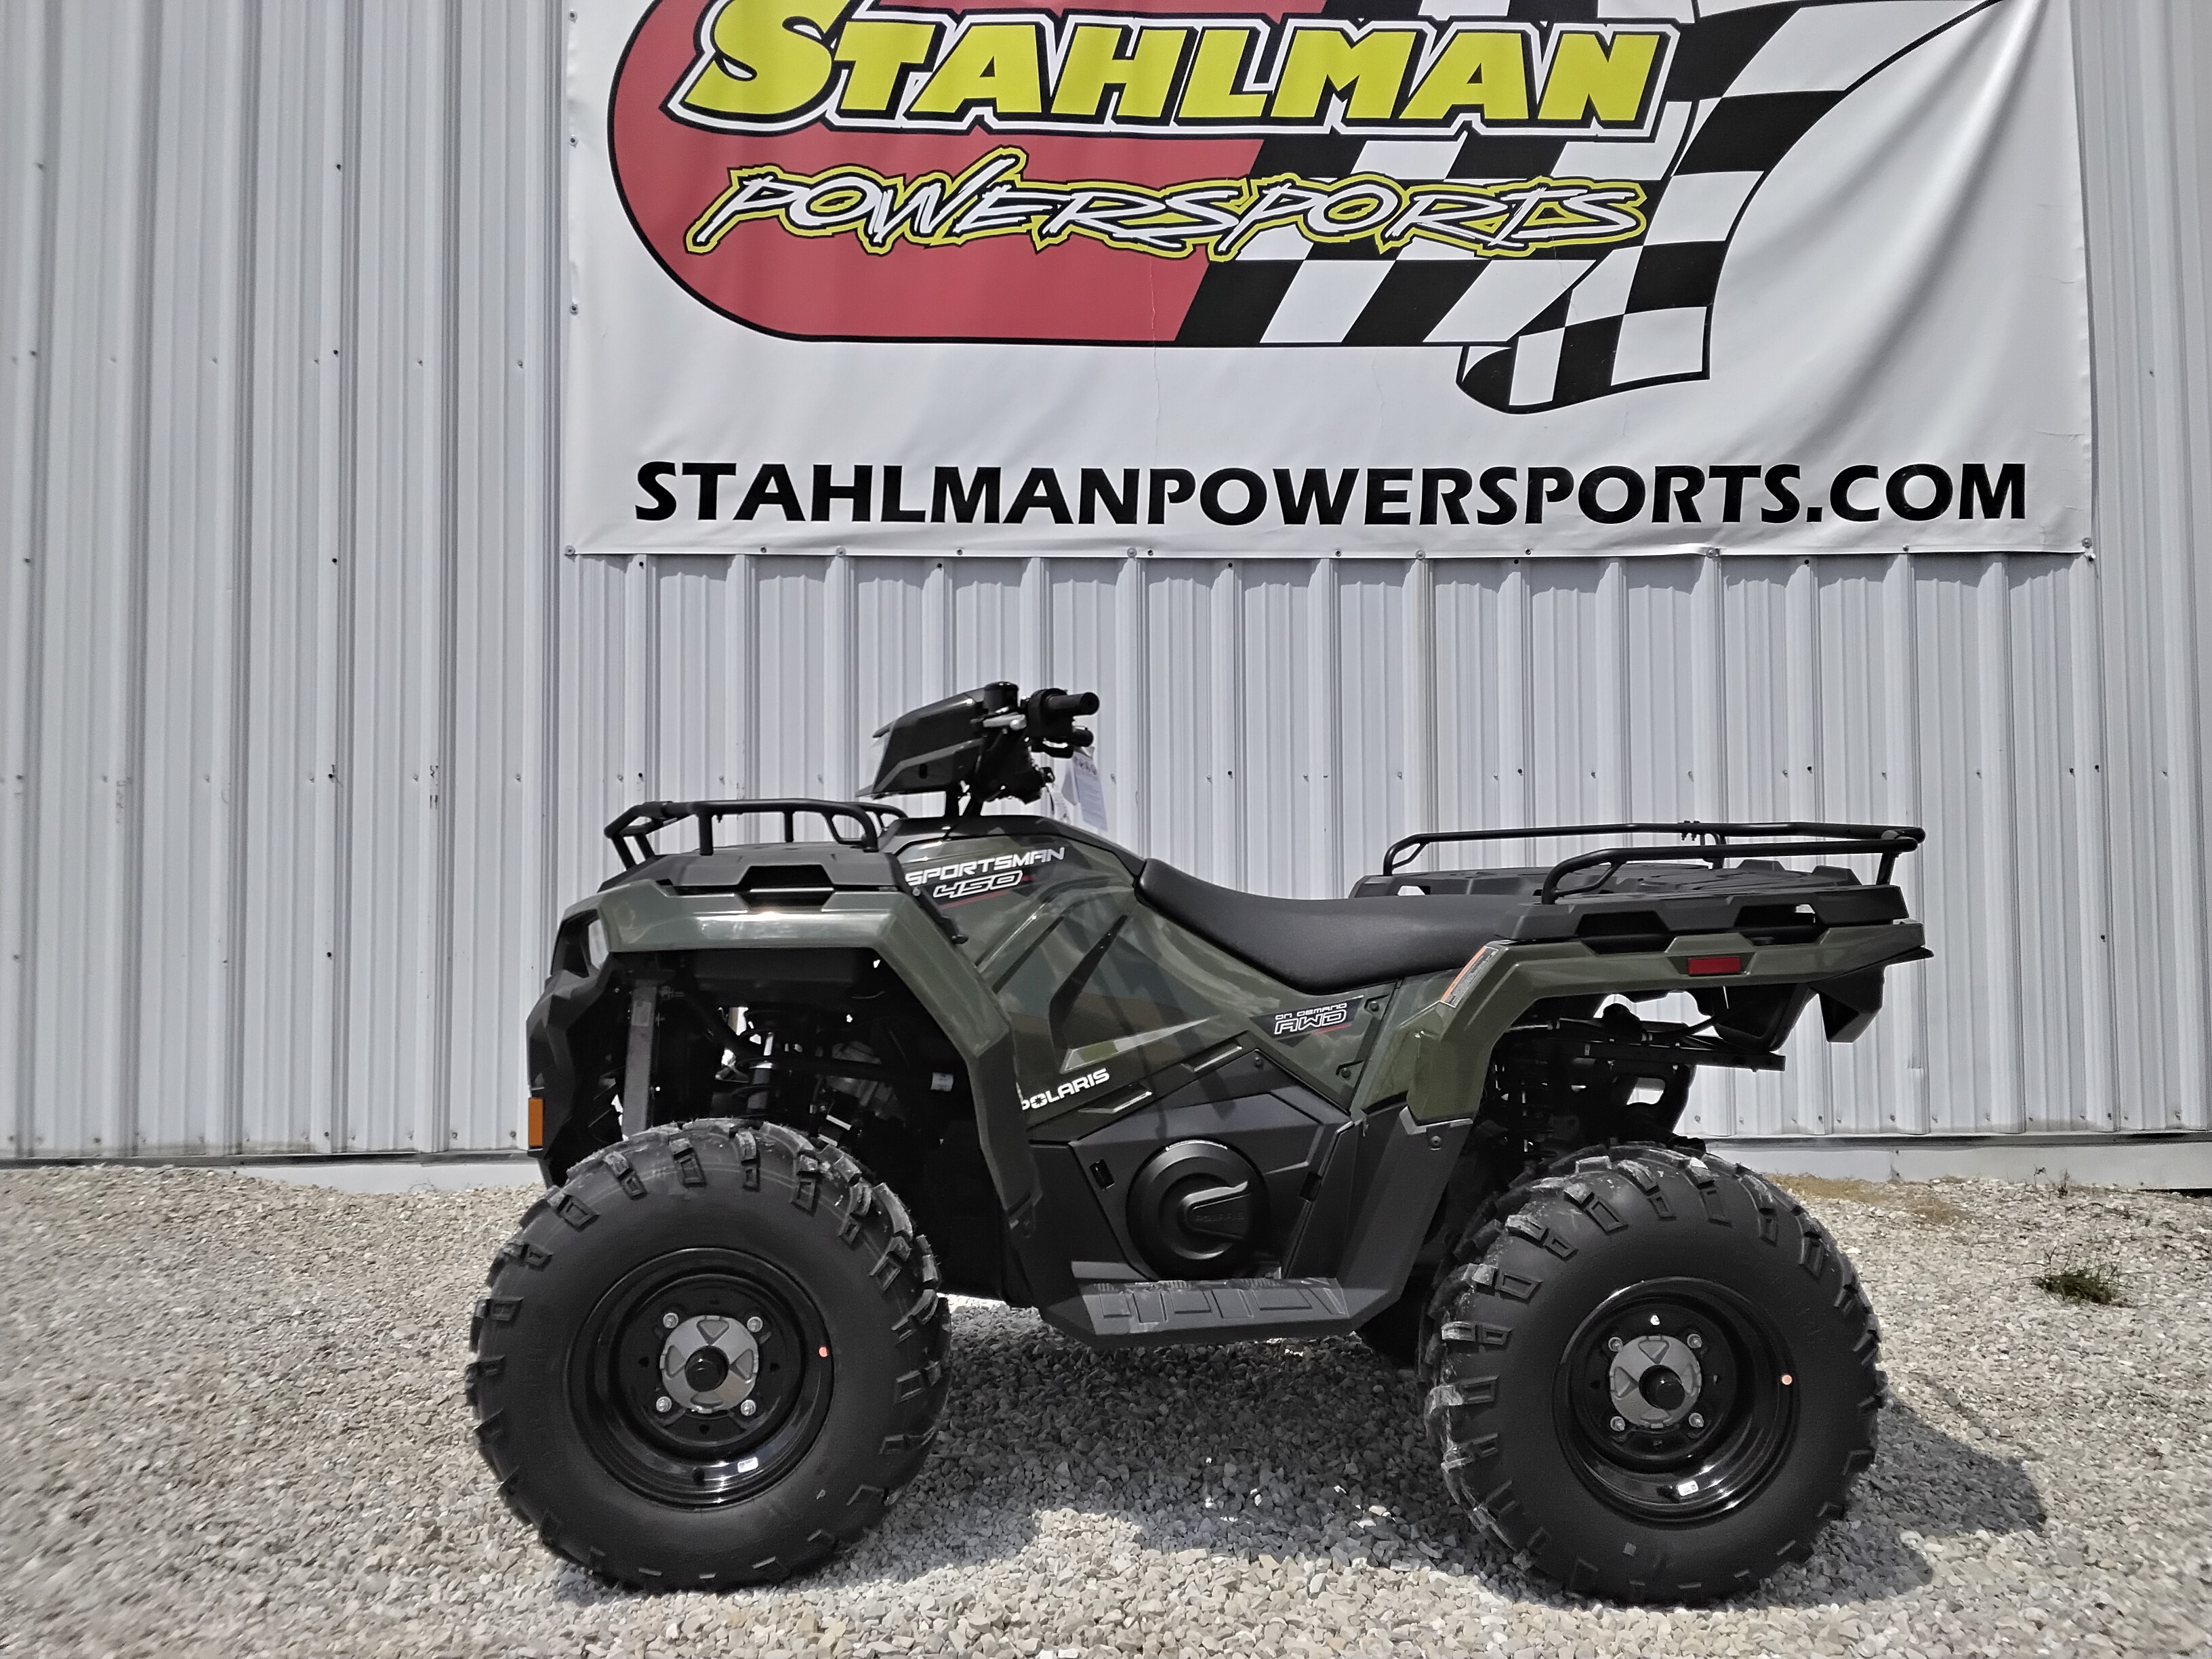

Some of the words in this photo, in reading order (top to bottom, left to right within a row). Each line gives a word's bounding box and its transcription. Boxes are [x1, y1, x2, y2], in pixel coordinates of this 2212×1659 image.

[668, 0, 1674, 136] STAHLMAN
[690, 150, 1641, 256] POWERSPORTS
[635, 461, 2026, 526] STAHLMANPOWERSPORTS.COM
[905, 847, 1065, 886] SPORTSMAN
[933, 870, 1023, 899] 450
[1274, 1009, 1347, 1035] AWD
[1296, 1002, 1347, 1017] DEMAND
